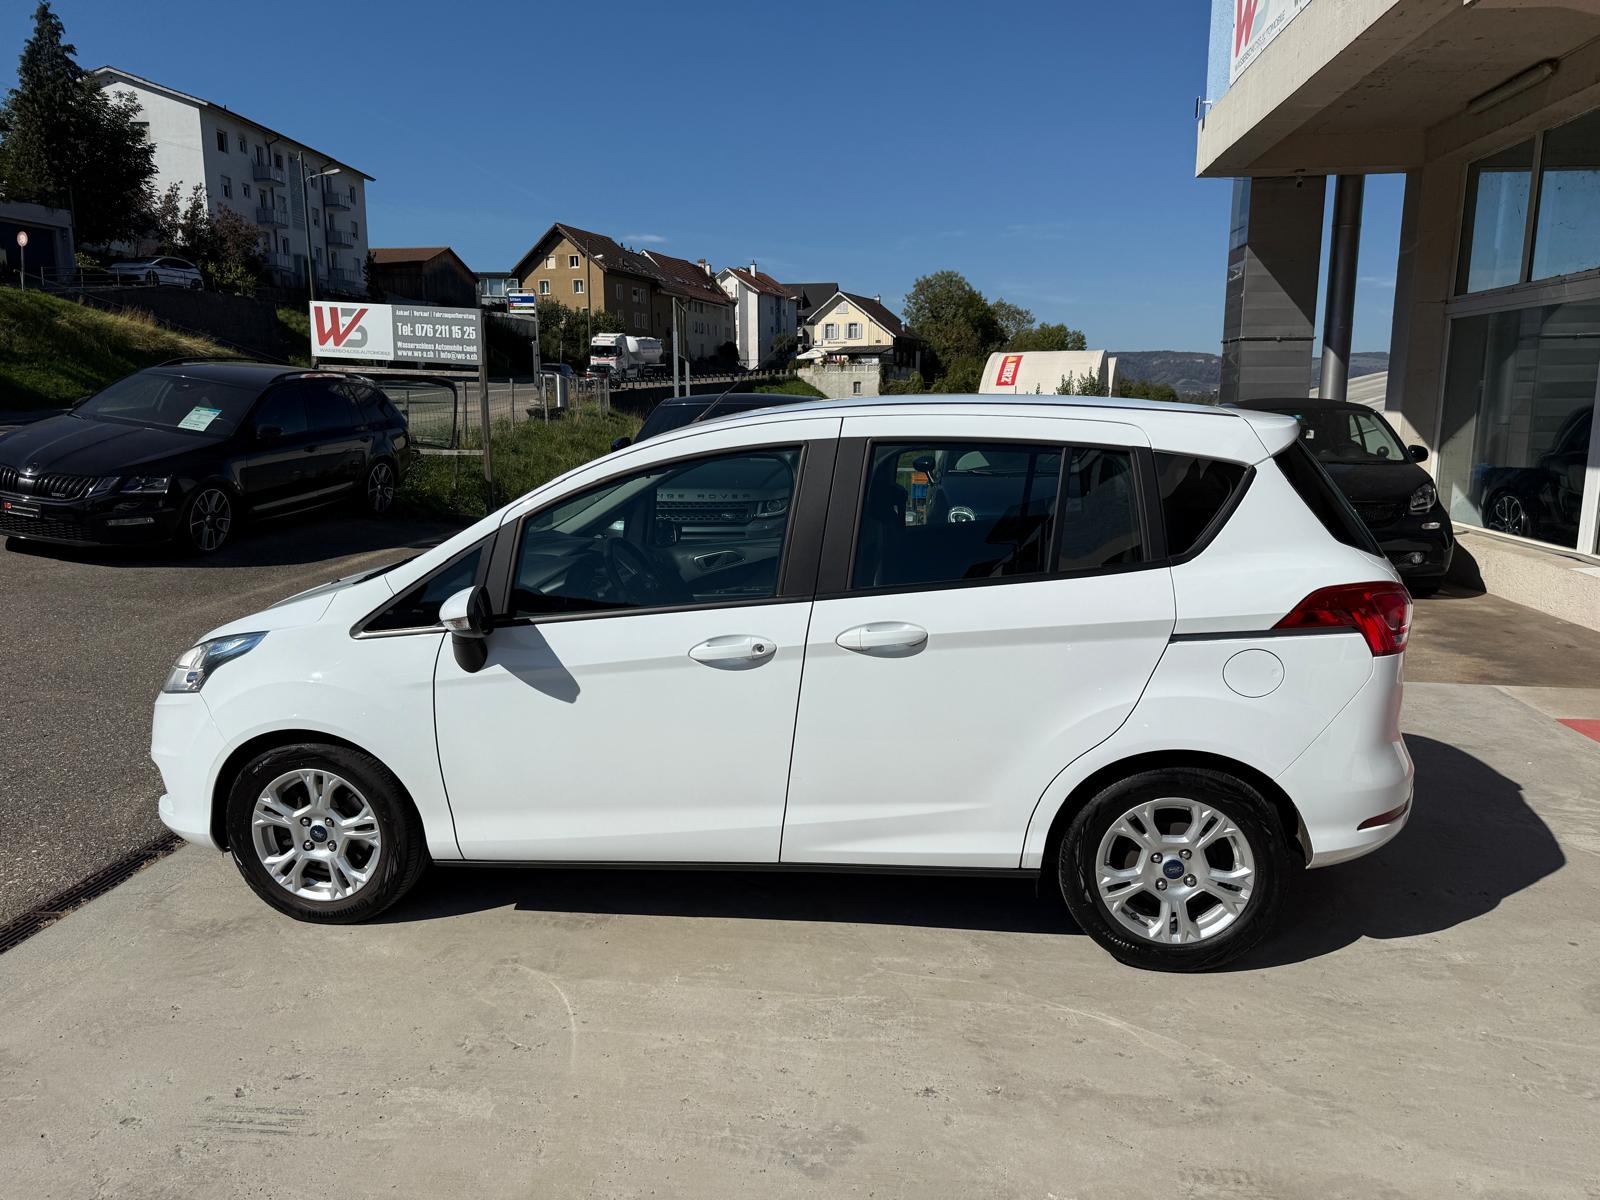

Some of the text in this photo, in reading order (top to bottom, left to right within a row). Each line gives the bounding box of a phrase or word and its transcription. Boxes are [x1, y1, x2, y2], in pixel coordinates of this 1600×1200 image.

[415, 323, 434, 337] 076
[435, 325, 450, 338] 211
[451, 325, 462, 339] 15
[463, 326, 476, 339] 25
[435, 343, 463, 352] Automobile
[463, 344, 478, 353] GmbH
[1001, 362, 1017, 383] MERZ
